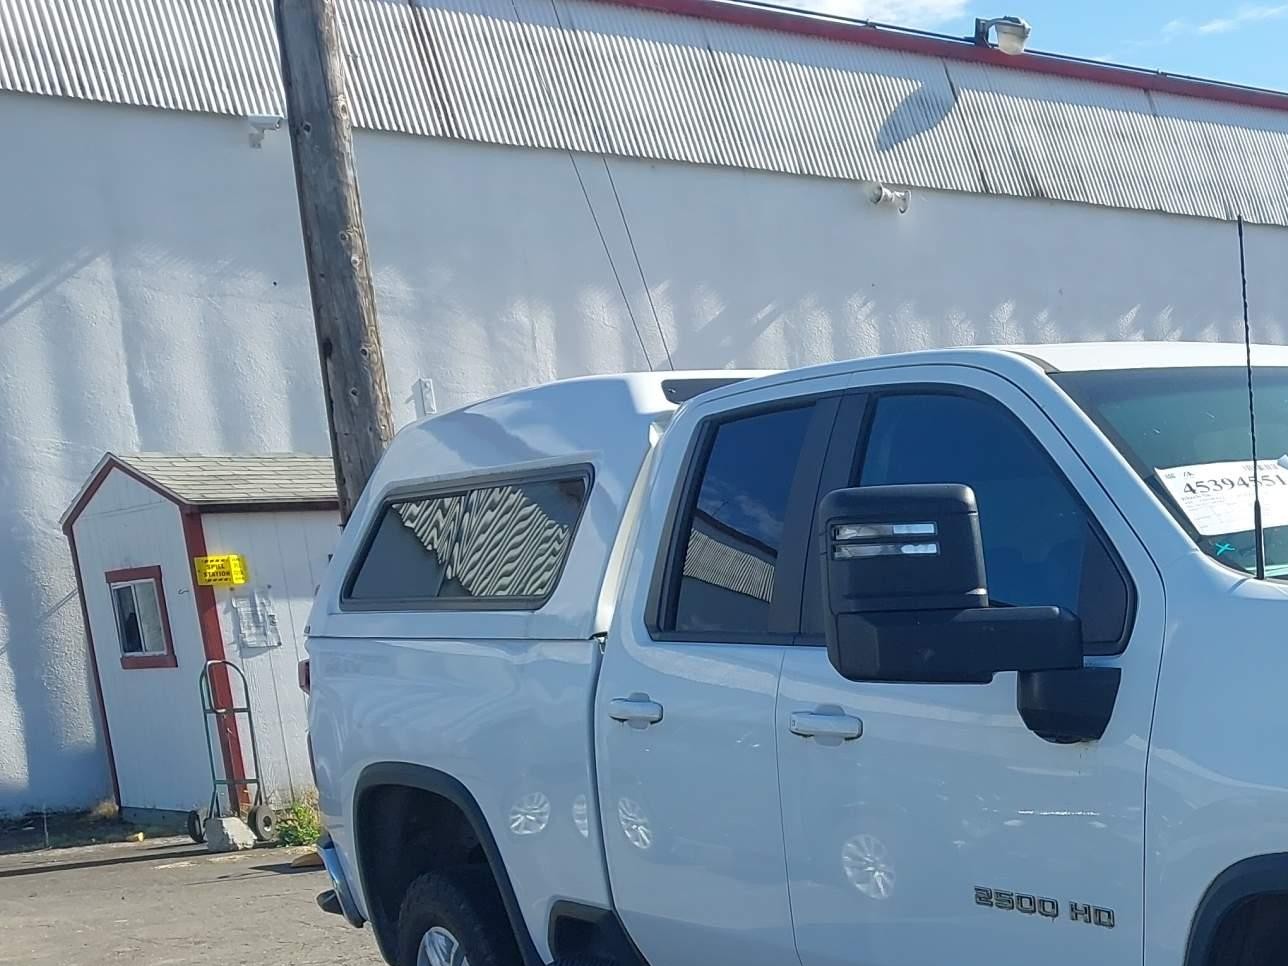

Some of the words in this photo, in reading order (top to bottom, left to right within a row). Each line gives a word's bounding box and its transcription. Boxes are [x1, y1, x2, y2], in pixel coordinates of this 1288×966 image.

[1183, 474, 1288, 495] 45394551
[974, 886, 1059, 918] 2500
[1069, 901, 1115, 928] HD
